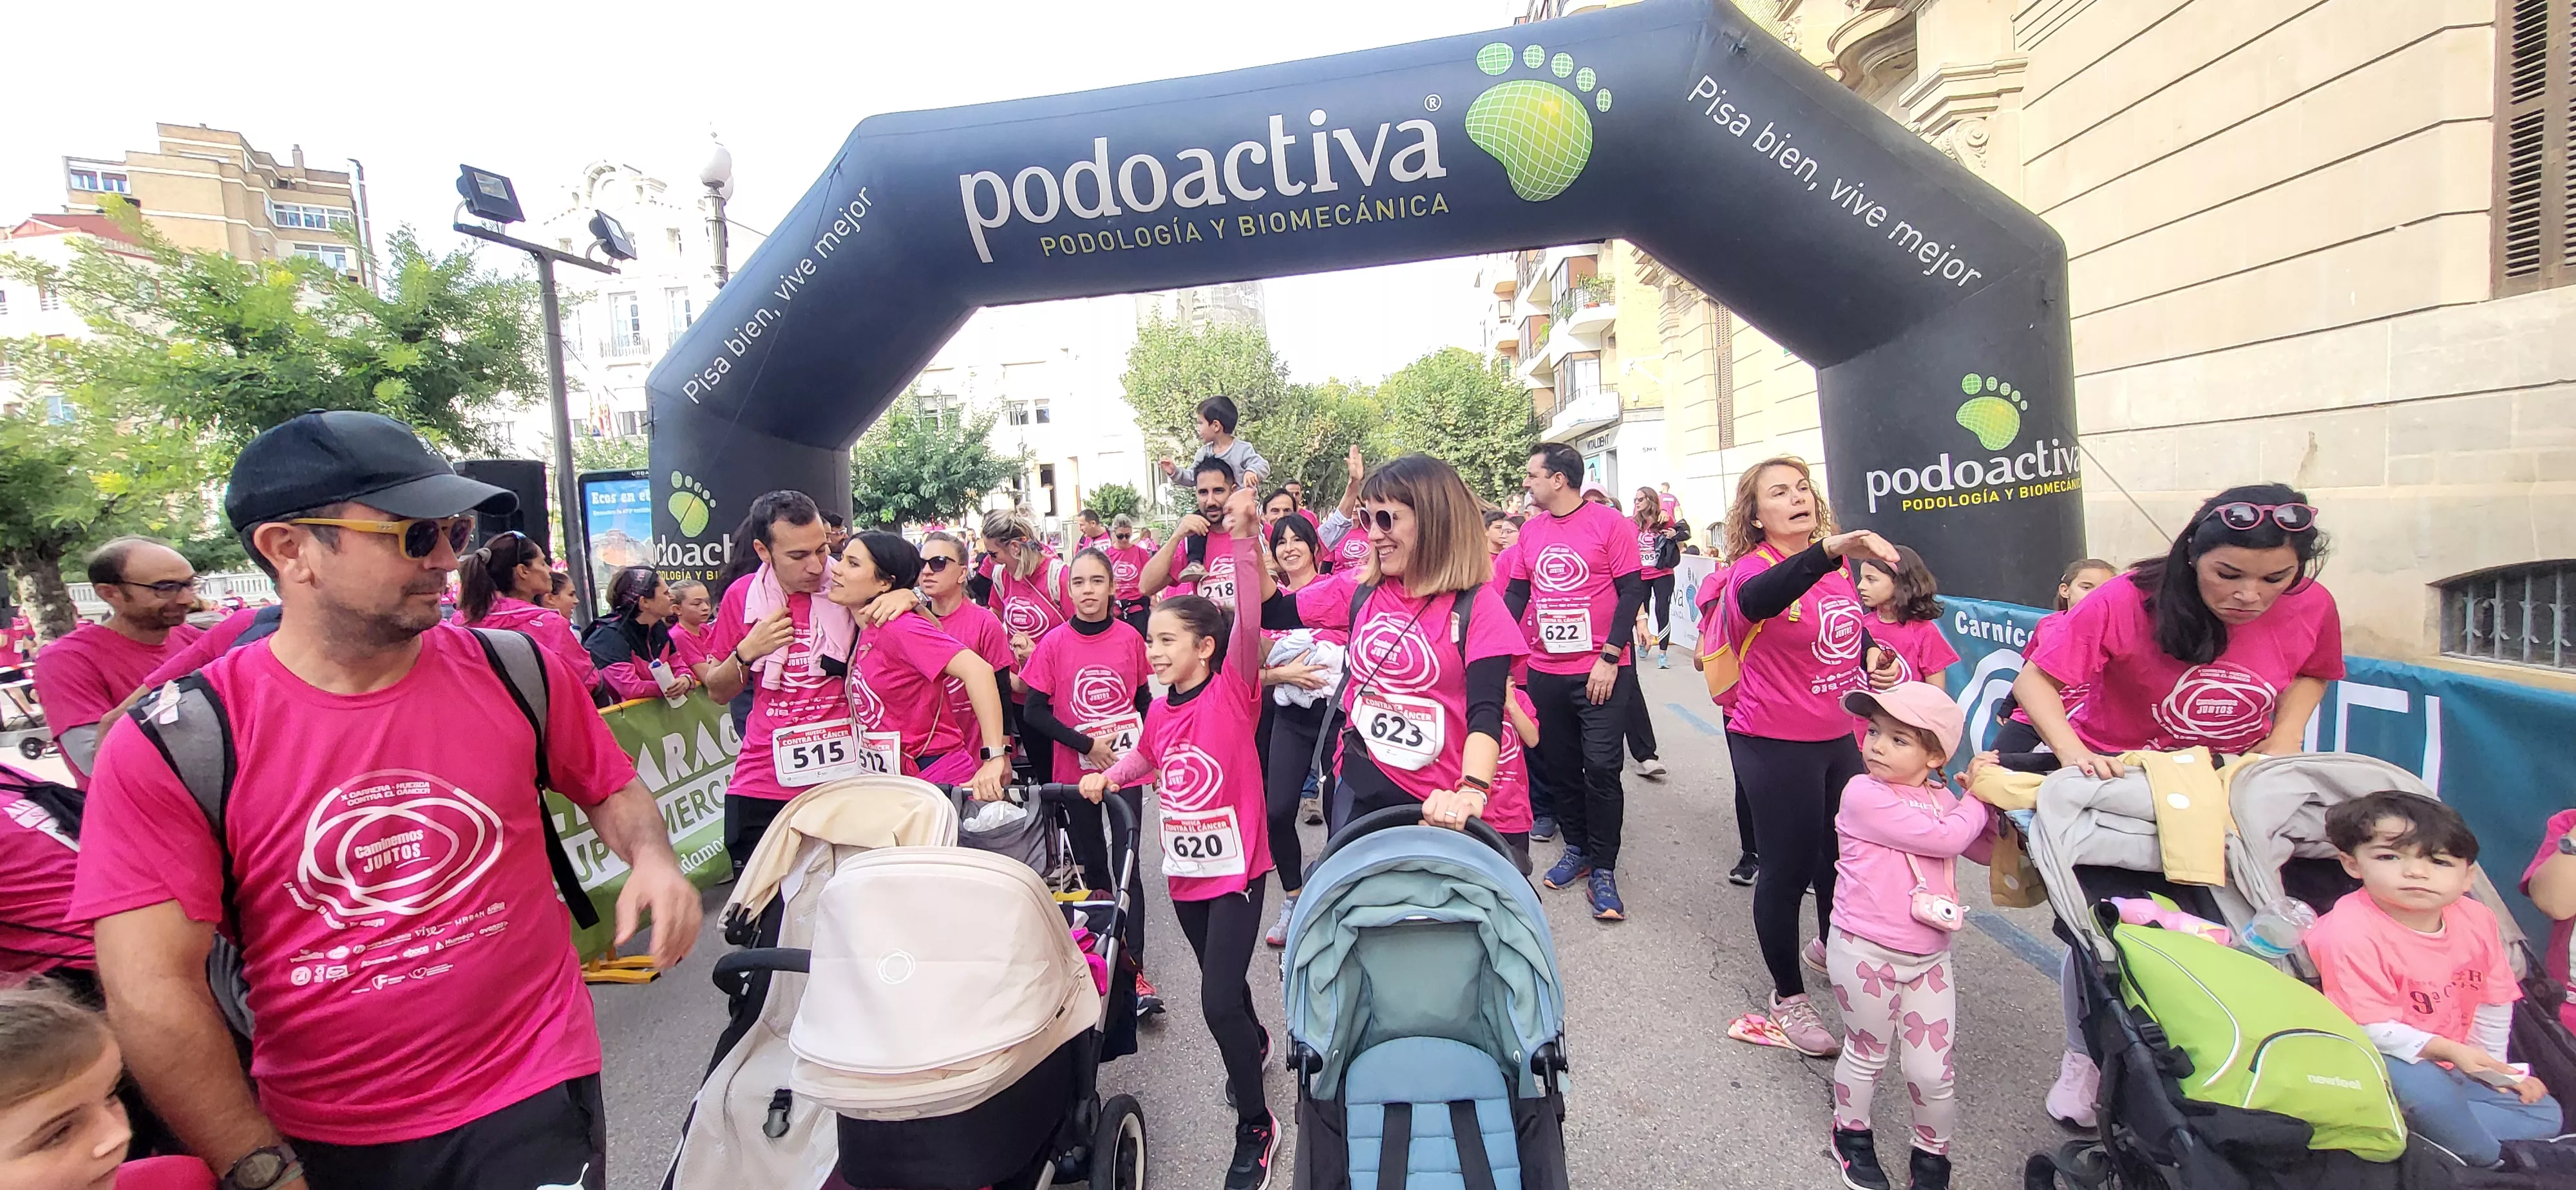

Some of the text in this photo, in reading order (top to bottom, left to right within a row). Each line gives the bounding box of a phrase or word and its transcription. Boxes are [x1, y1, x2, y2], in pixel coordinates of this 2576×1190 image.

[960, 108, 1446, 263] podoactiva
[1687, 75, 1982, 287] Pisa bien, vive mejor
[1041, 191, 1450, 257] PODOLOGÍA Y BIOMECÁNICA
[682, 187, 872, 404] Pisa bien, vive mejor
[591, 491, 616, 504] Ecos
[621, 492, 635, 502] en
[1902, 488, 2000, 511] PODOLOGÍA
[2004, 488, 2013, 500] Y
[695, 571, 702, 580] Y
[1203, 582, 1233, 598] 218
[1546, 625, 1579, 640] 622
[782, 736, 812, 746] CONTRA
[823, 730, 849, 739] CÁNCER
[1110, 732, 1132, 752] 24
[1371, 713, 1423, 747] 623
[636, 713, 743, 793] ARAG
[793, 741, 844, 769] 515
[859, 748, 887, 773] 512
[346, 793, 383, 806] CONTRA
[1198, 820, 1227, 832] CÁNCER
[354, 829, 424, 859] Caminemos
[1174, 835, 1222, 858] 620
[363, 842, 421, 873] JUNTOS
